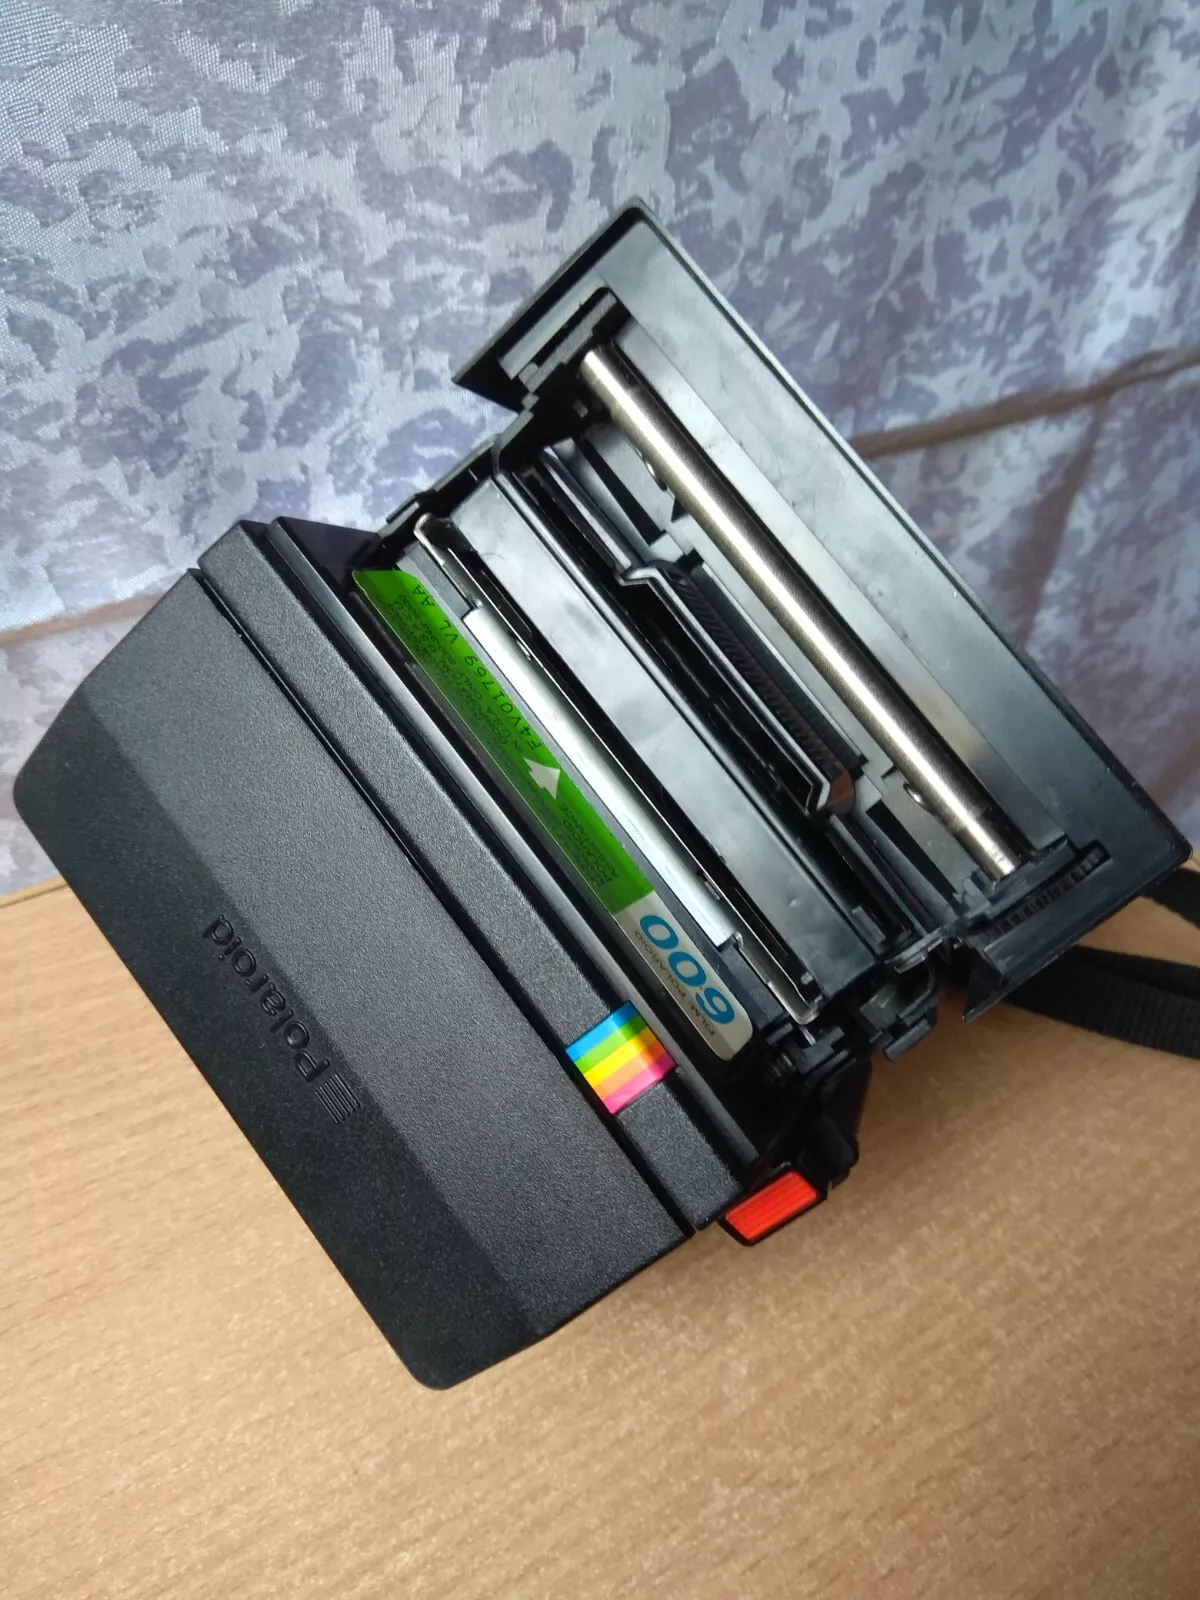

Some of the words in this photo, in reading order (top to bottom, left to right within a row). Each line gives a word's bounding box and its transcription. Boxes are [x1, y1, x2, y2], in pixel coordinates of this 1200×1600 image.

[411, 583, 435, 607] AA
[438, 618, 459, 644] VL
[633, 930, 686, 997] POLAROID
[639, 915, 735, 1024] 600
[200, 912, 332, 1084] Polaroid
